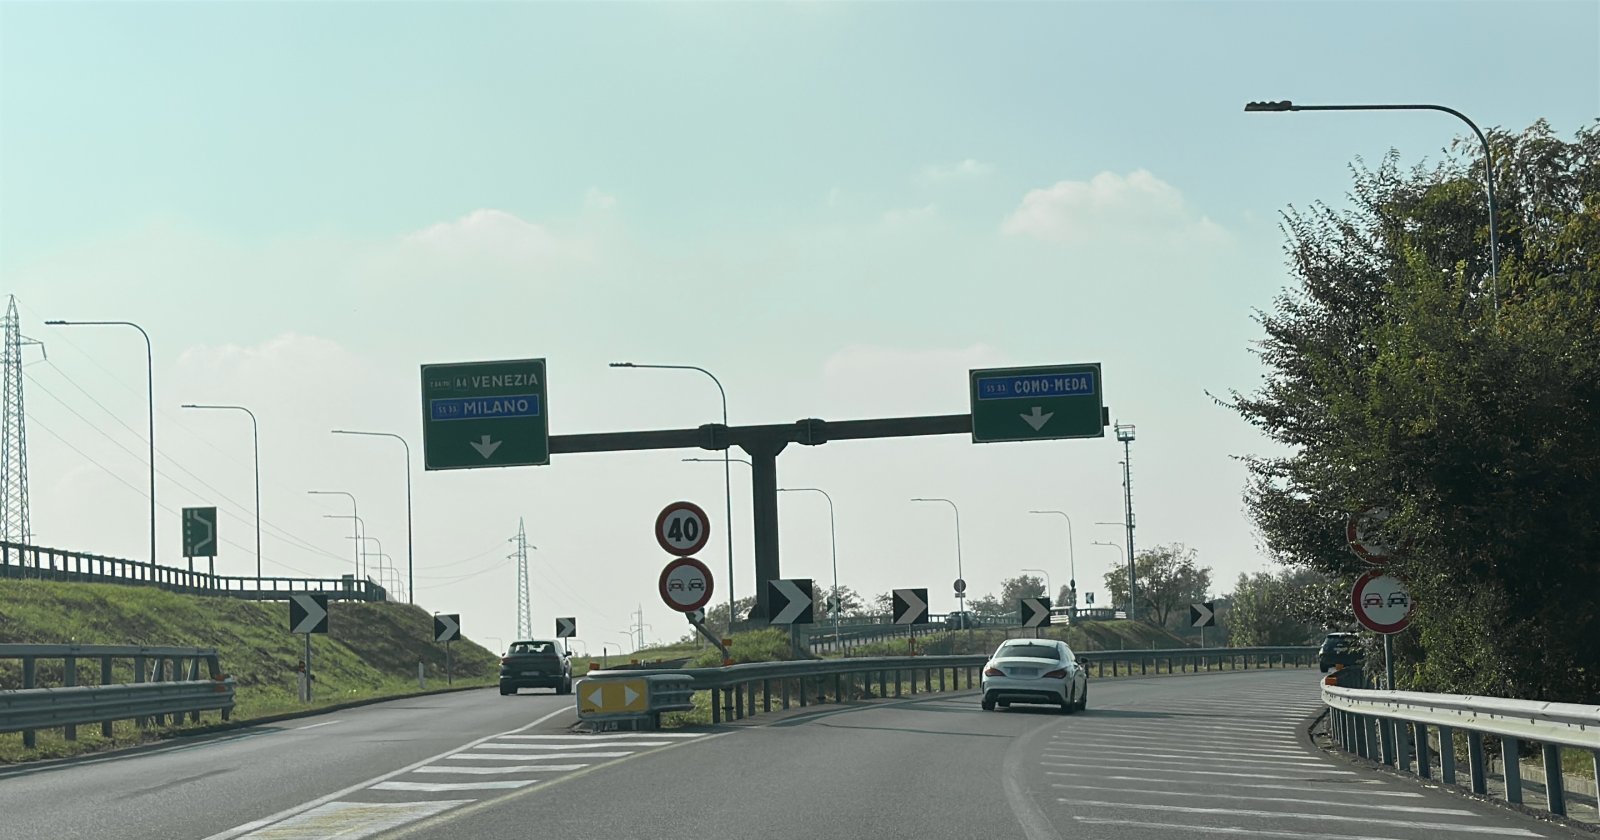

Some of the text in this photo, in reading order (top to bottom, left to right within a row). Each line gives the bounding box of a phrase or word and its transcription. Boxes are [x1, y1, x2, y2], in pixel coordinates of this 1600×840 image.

[456, 377, 468, 388] A4
[472, 373, 538, 389] VENEZIA
[1014, 377, 1088, 394] COMO-MEDA
[464, 399, 528, 416] MILANO
[668, 516, 698, 542] 40
